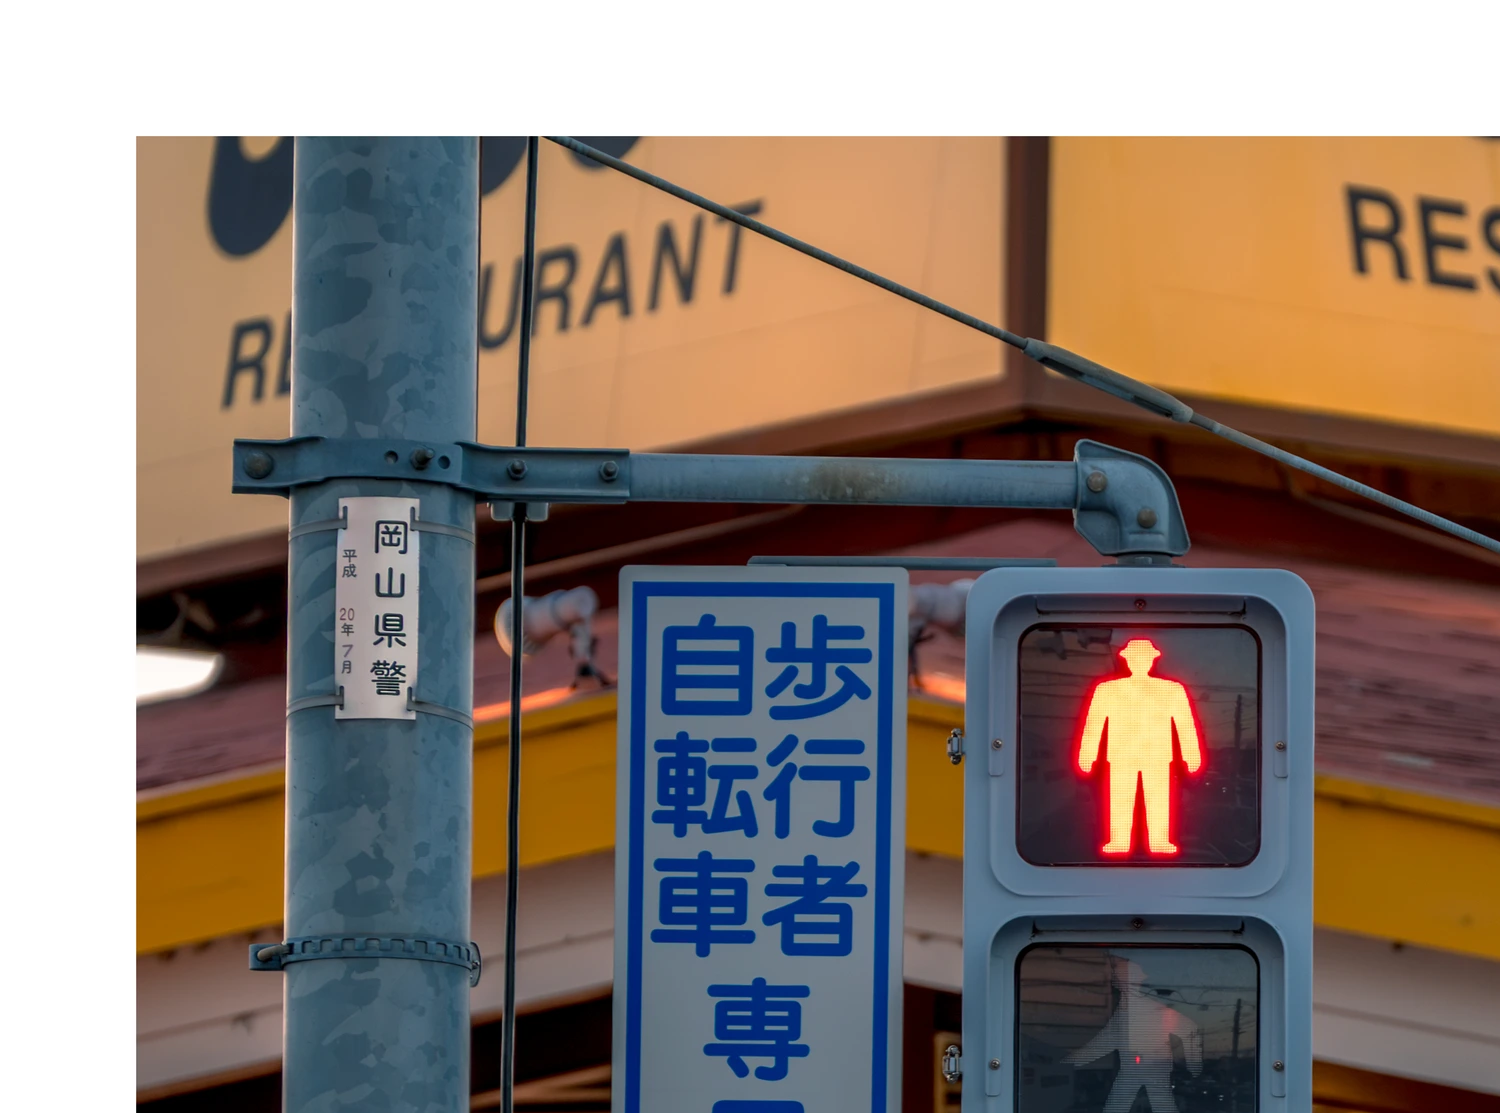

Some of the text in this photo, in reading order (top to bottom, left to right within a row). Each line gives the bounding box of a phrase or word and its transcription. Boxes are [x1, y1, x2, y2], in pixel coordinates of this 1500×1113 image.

[220, 198, 767, 410] RURANT
[370, 520, 408, 696] 岡山県警
[650, 613, 759, 958] 自転車
[762, 614, 873, 957] 歩行者
